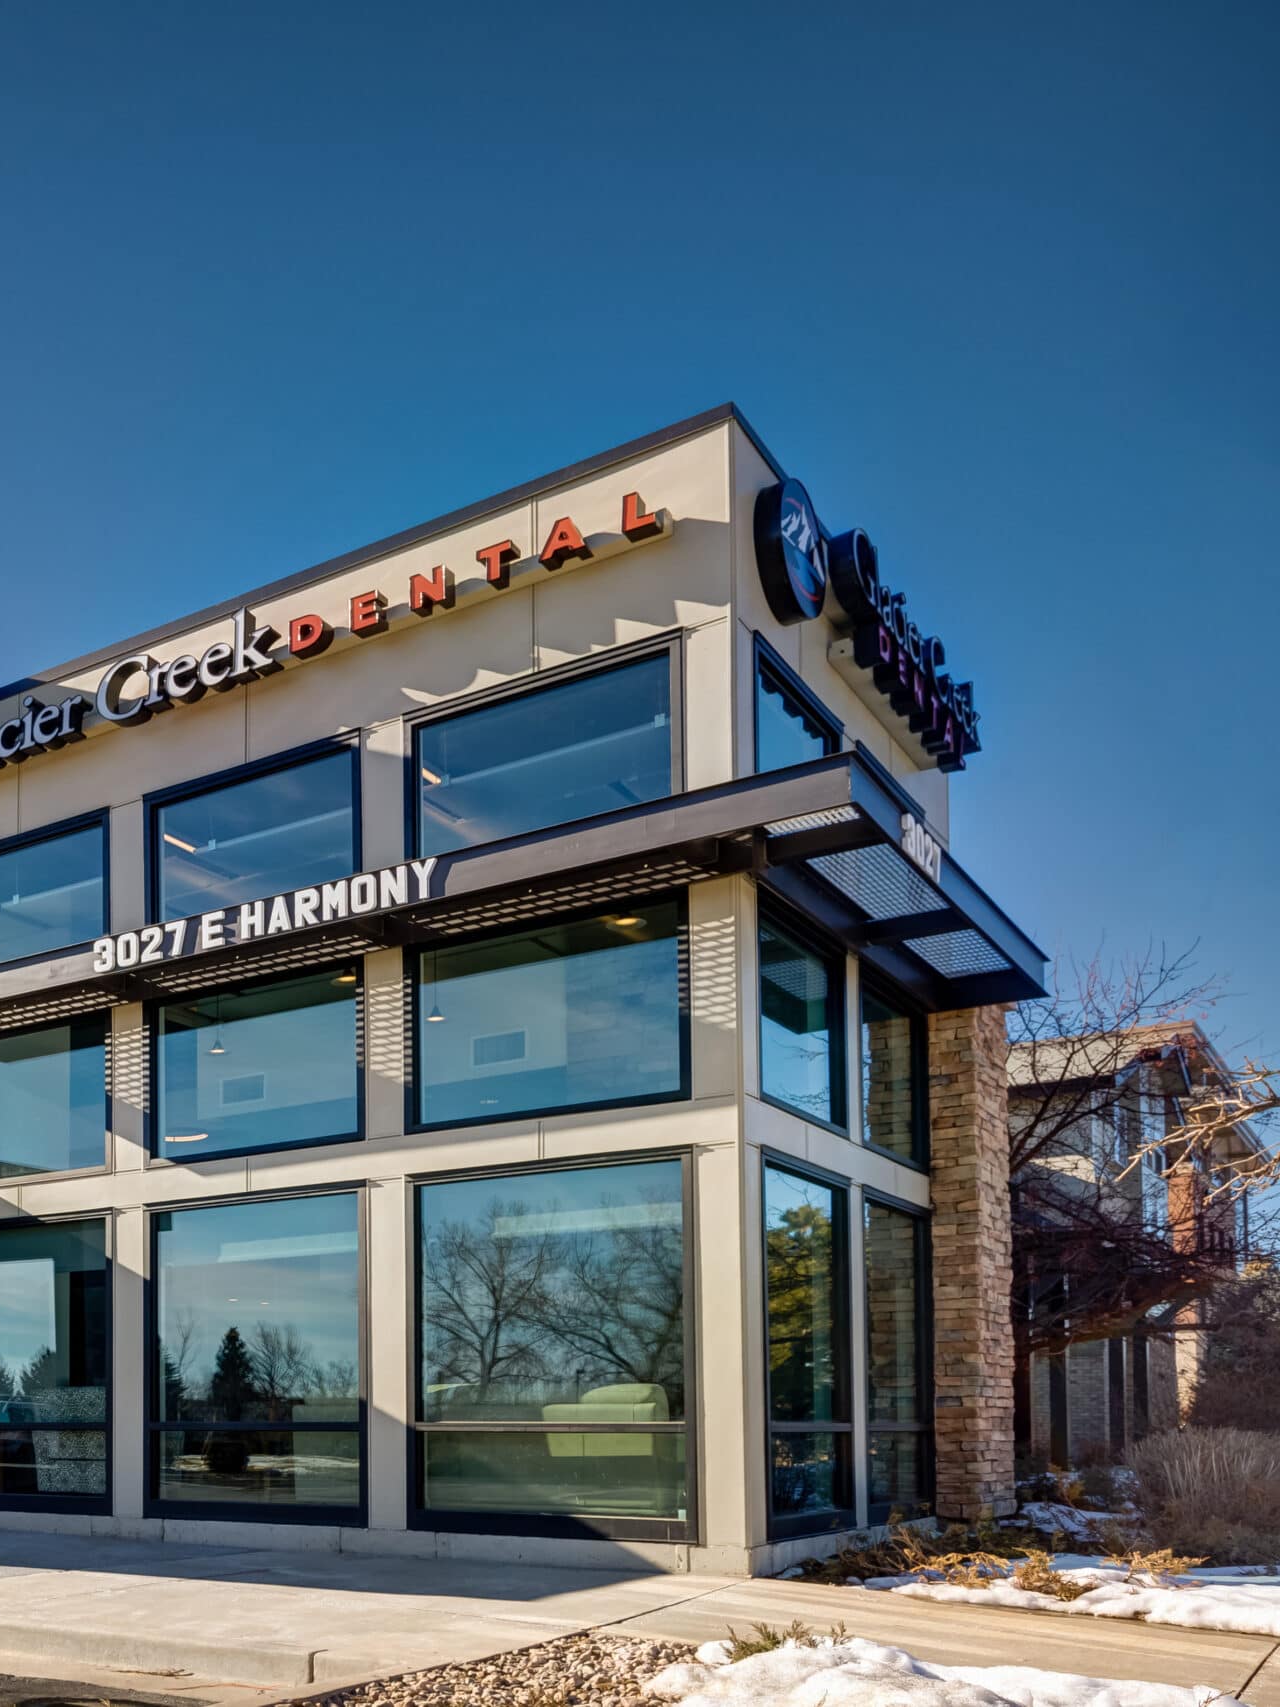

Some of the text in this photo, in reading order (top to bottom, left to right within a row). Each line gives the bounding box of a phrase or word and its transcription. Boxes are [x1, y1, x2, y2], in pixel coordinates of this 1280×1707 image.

[96, 606, 276, 721] Creek
[288, 491, 658, 655] DENTAL
[852, 527, 927, 676] Glacier
[878, 624, 966, 767] DENTAL
[93, 857, 438, 973] 3027 E HARMONY
[901, 812, 942, 884] 3027
